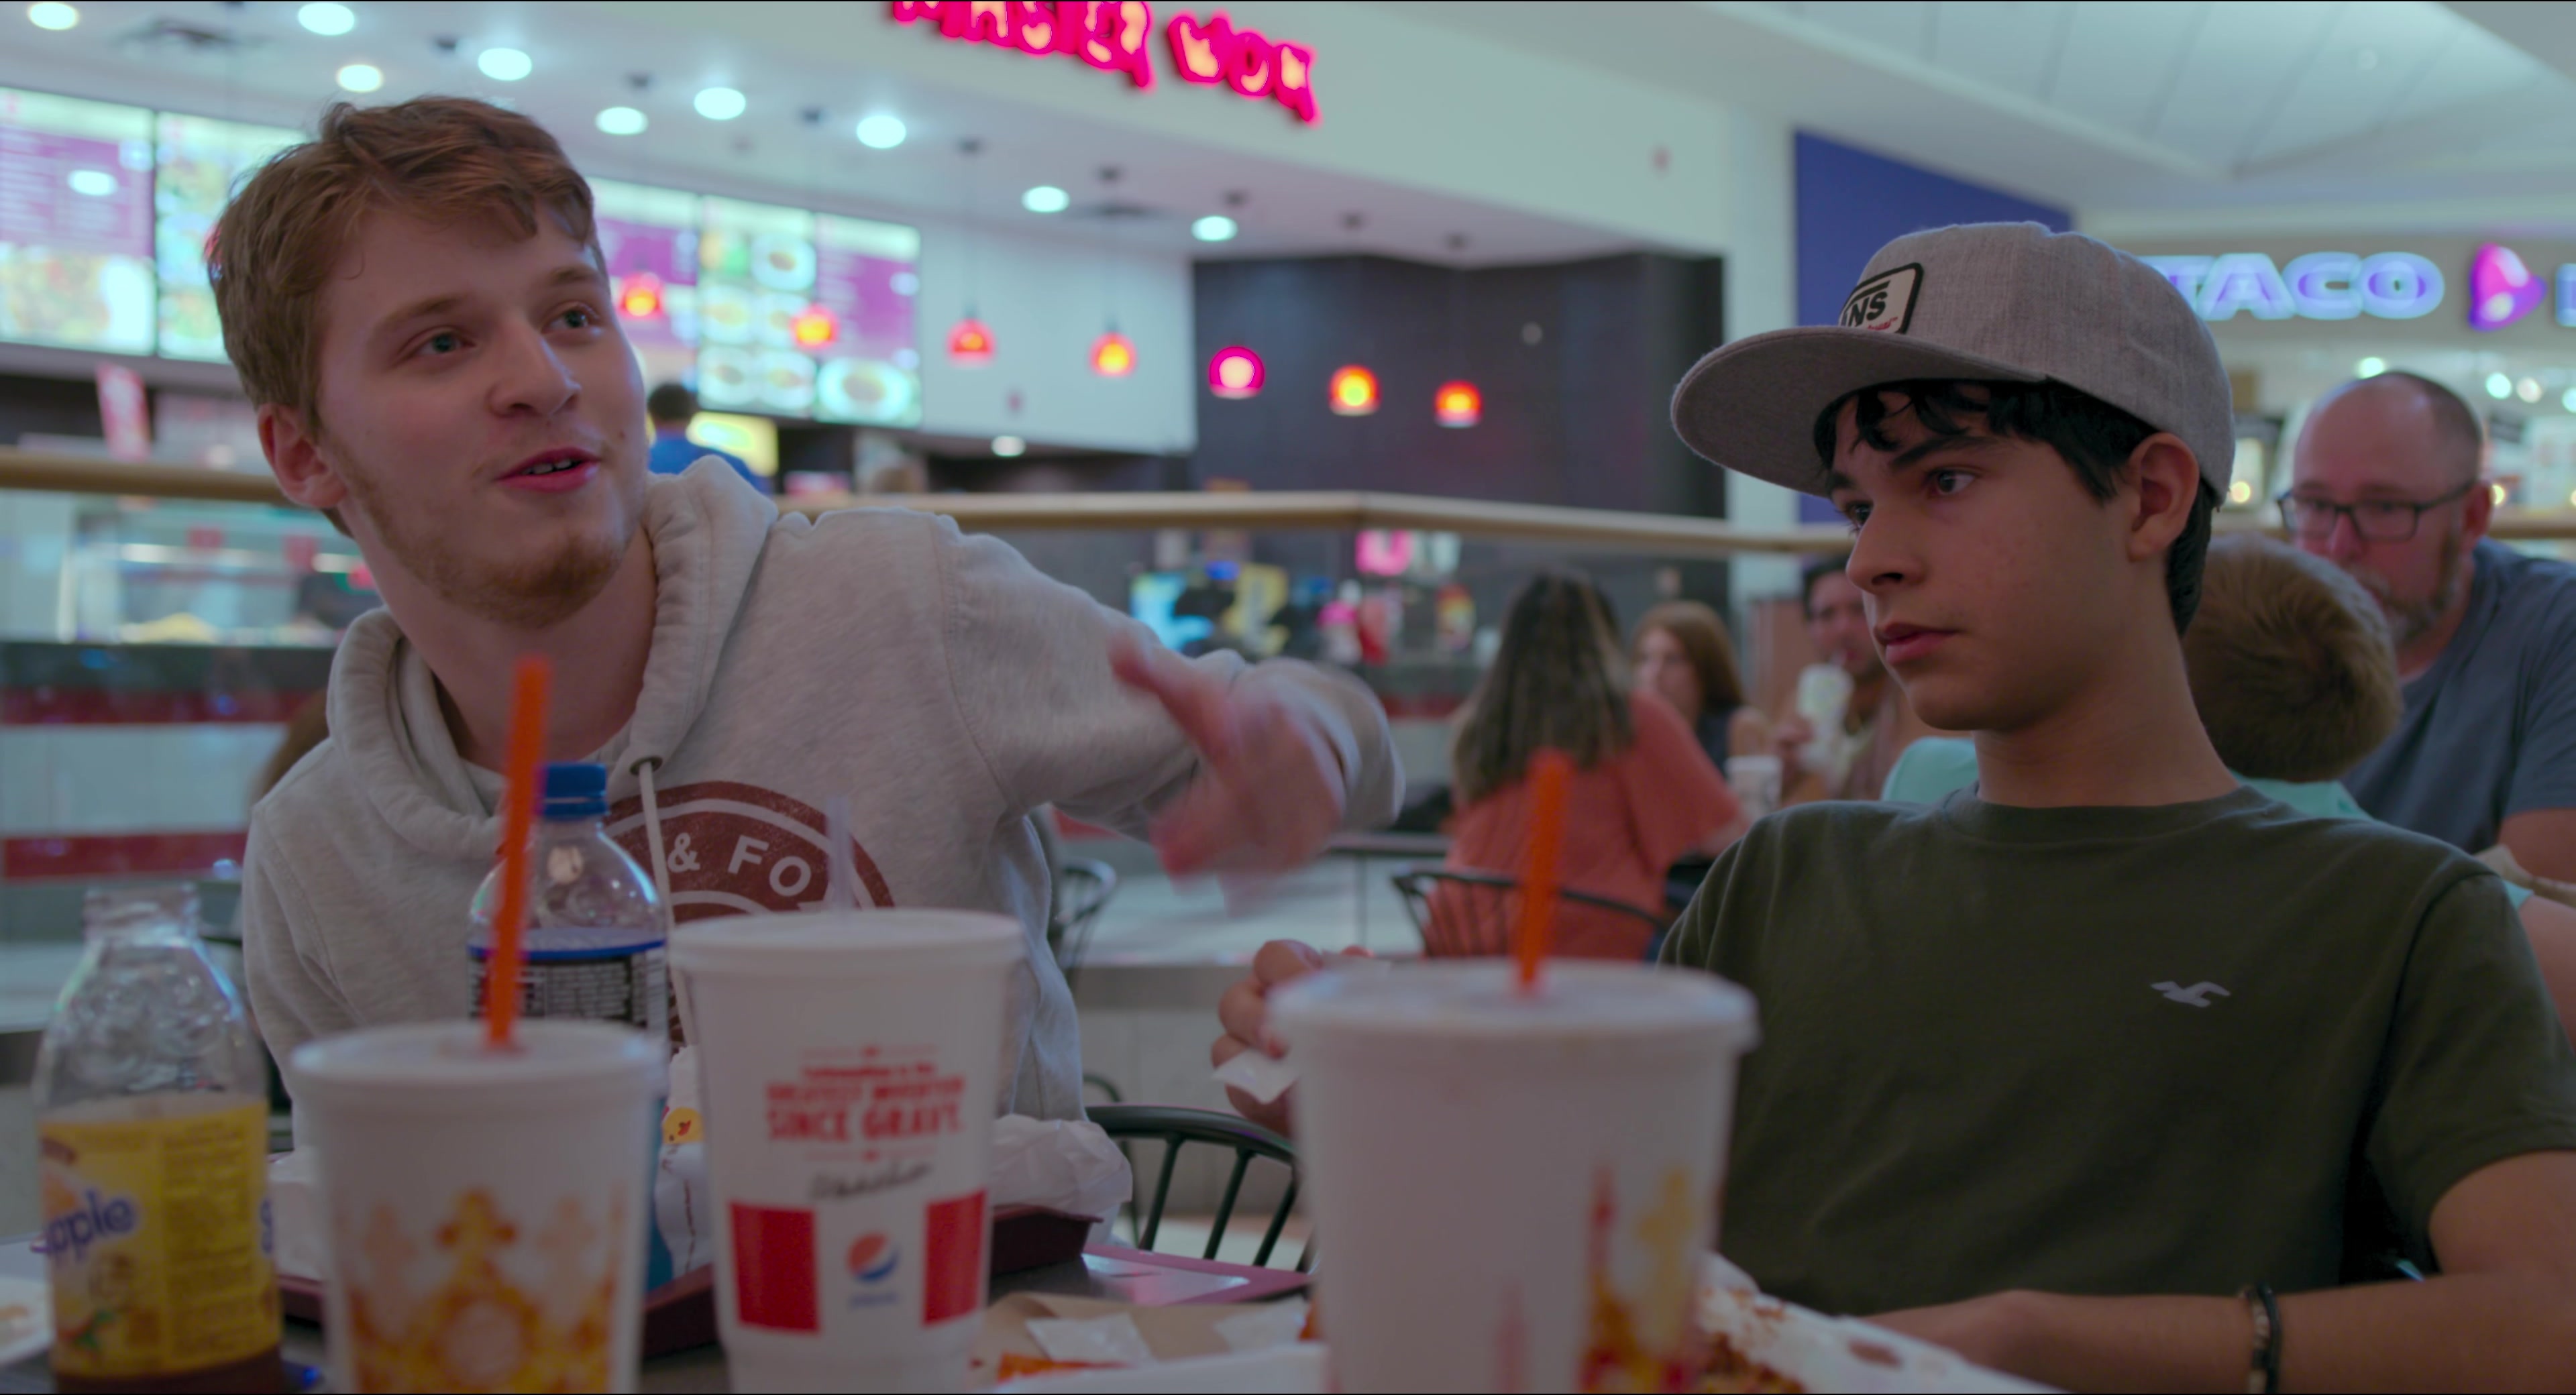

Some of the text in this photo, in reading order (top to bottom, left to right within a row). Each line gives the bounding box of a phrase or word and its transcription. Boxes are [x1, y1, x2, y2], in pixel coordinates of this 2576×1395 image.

[2137, 252, 2444, 320] TACO
[667, 832, 700, 873] &
[44, 1188, 136, 1266] pple
